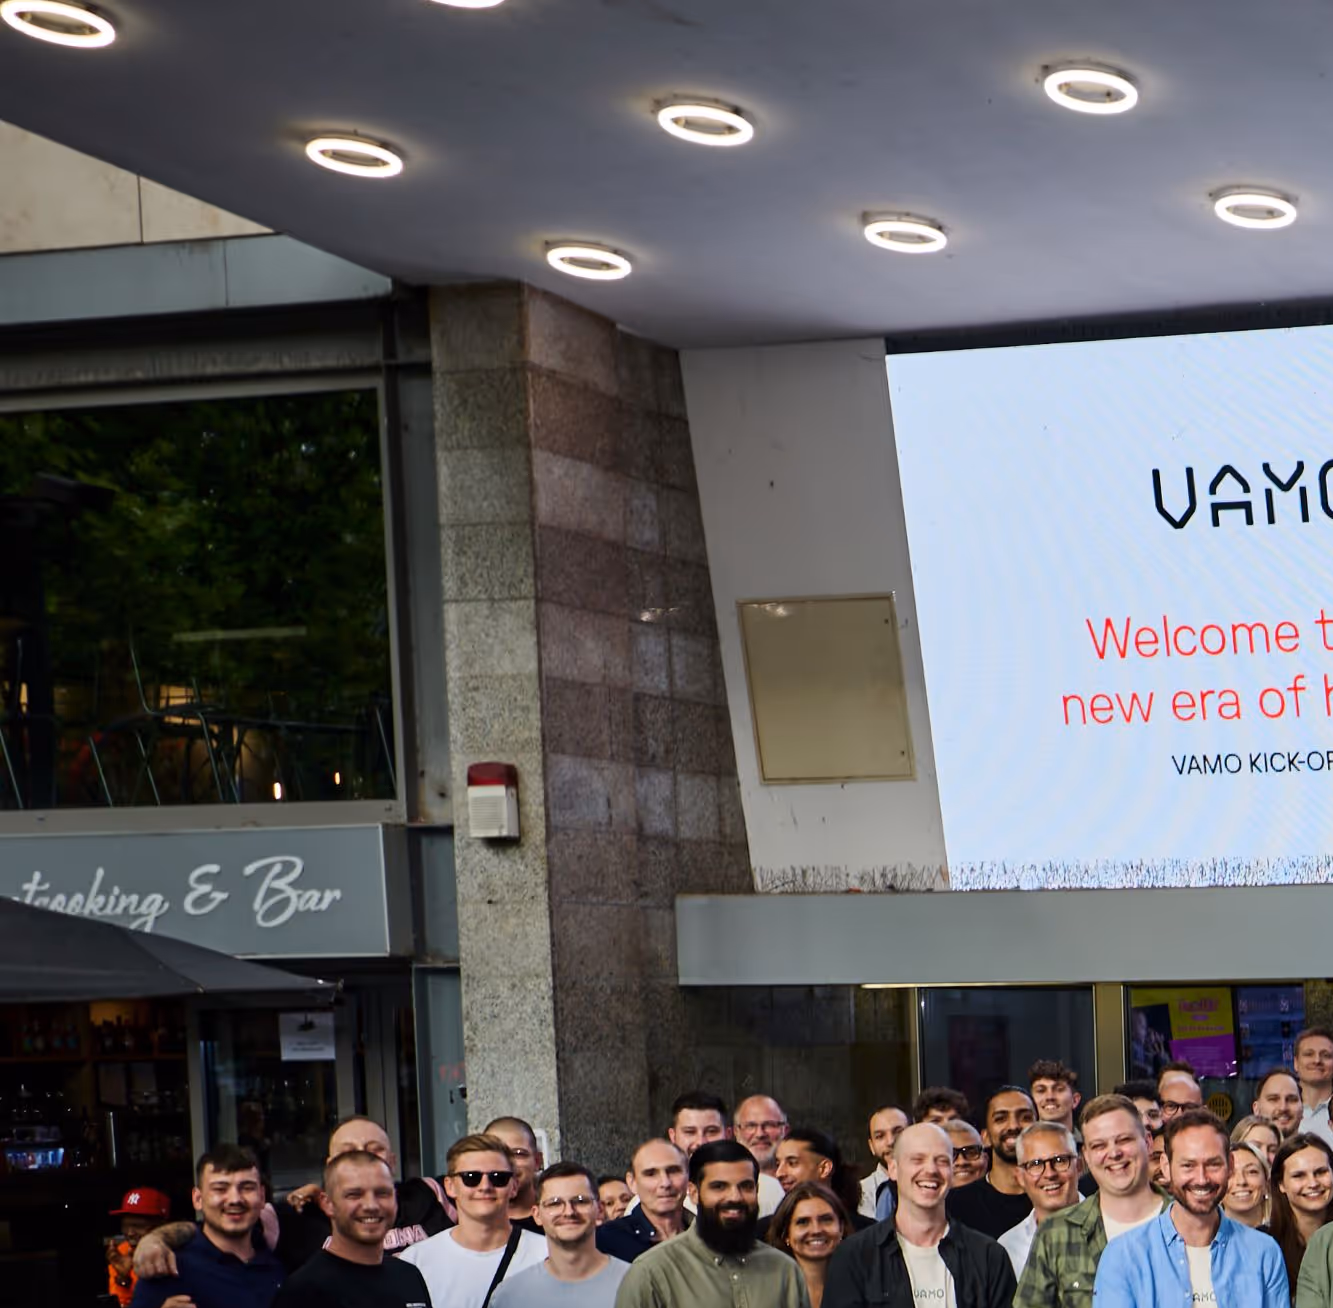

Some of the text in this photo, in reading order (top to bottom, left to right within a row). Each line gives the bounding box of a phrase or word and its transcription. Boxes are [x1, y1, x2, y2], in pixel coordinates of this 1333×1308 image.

[1086, 613, 1300, 660] Welcome
[1062, 689, 1154, 726] new
[1171, 688, 1242, 722] era
[1260, 675, 1306, 719] of
[1171, 752, 1242, 775] VAMO
[183, 863, 230, 916] &
[243, 855, 342, 928] Bar
[1191, 1291, 1217, 1302] AMO
